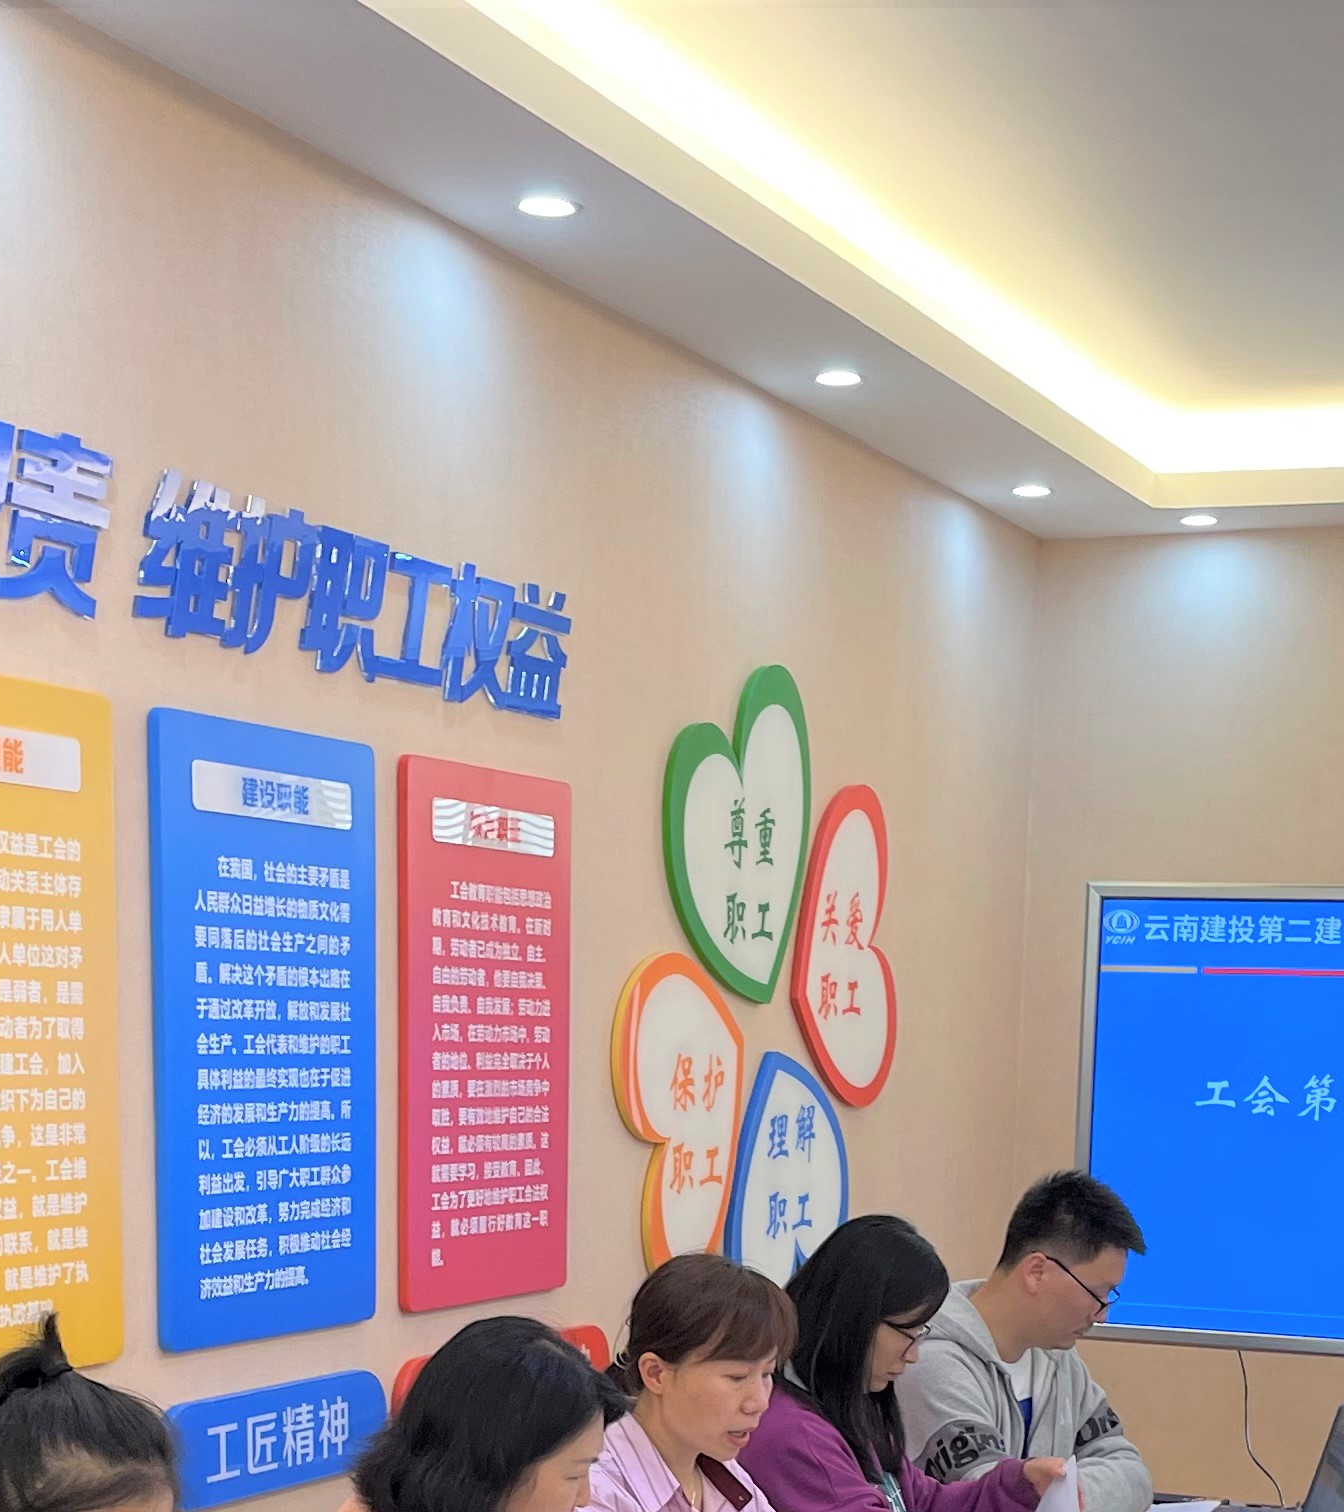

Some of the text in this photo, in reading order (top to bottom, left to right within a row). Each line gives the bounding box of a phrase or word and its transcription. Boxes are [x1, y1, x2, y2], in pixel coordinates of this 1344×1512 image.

[133, 469, 572, 721] 维护职工权益
[242, 776, 310, 815] 建设职能
[724, 798, 776, 869] 尊重
[723, 892, 774, 944] 职工
[821, 890, 864, 950] 关爱
[818, 972, 862, 1020] 职工
[669, 1052, 725, 1113] 保护
[768, 1103, 816, 1164] 理解
[669, 1144, 723, 1195] 职工
[766, 1191, 813, 1240] 职工
[206, 1396, 350, 1485] 工匠精神
